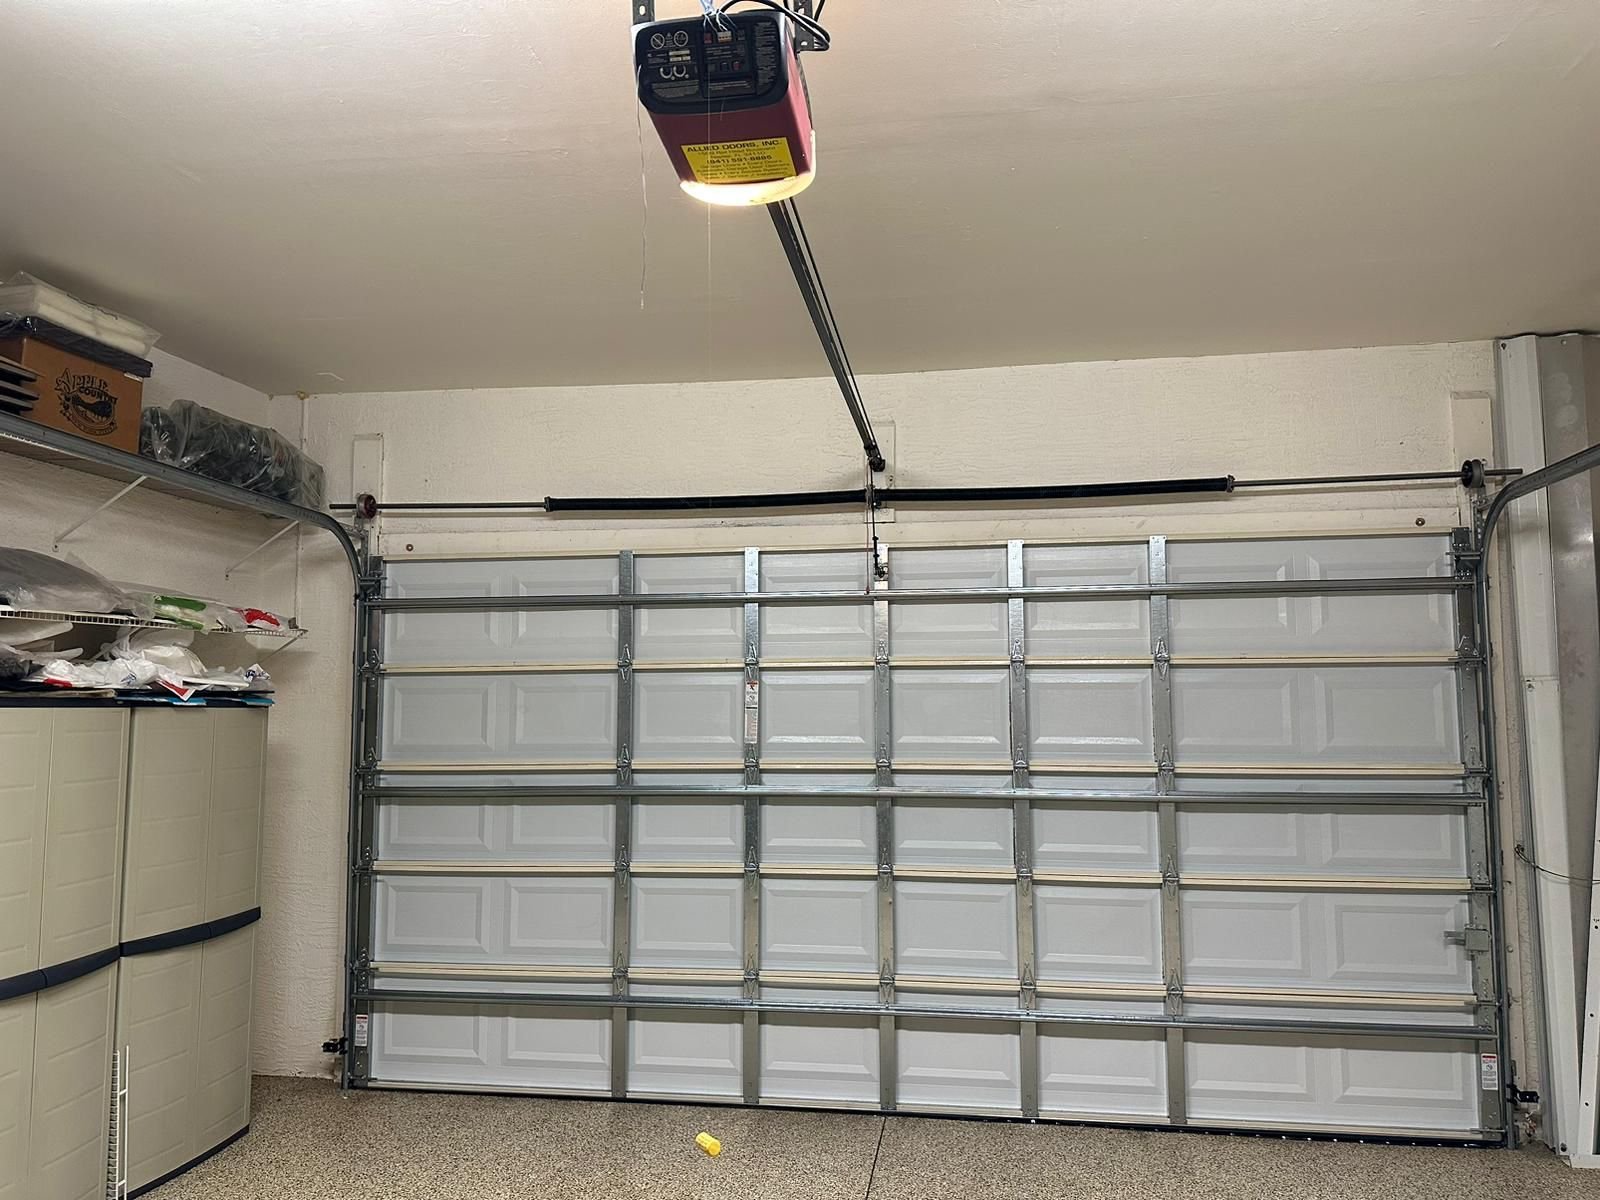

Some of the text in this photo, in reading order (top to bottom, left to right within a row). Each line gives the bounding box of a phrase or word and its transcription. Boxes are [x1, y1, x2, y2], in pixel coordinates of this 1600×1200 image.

[687, 144, 720, 152] ALLIED
[722, 141, 760, 150] DOORS,
[55, 367, 109, 394] APPLE
[79, 387, 118, 404] COUNTRY
